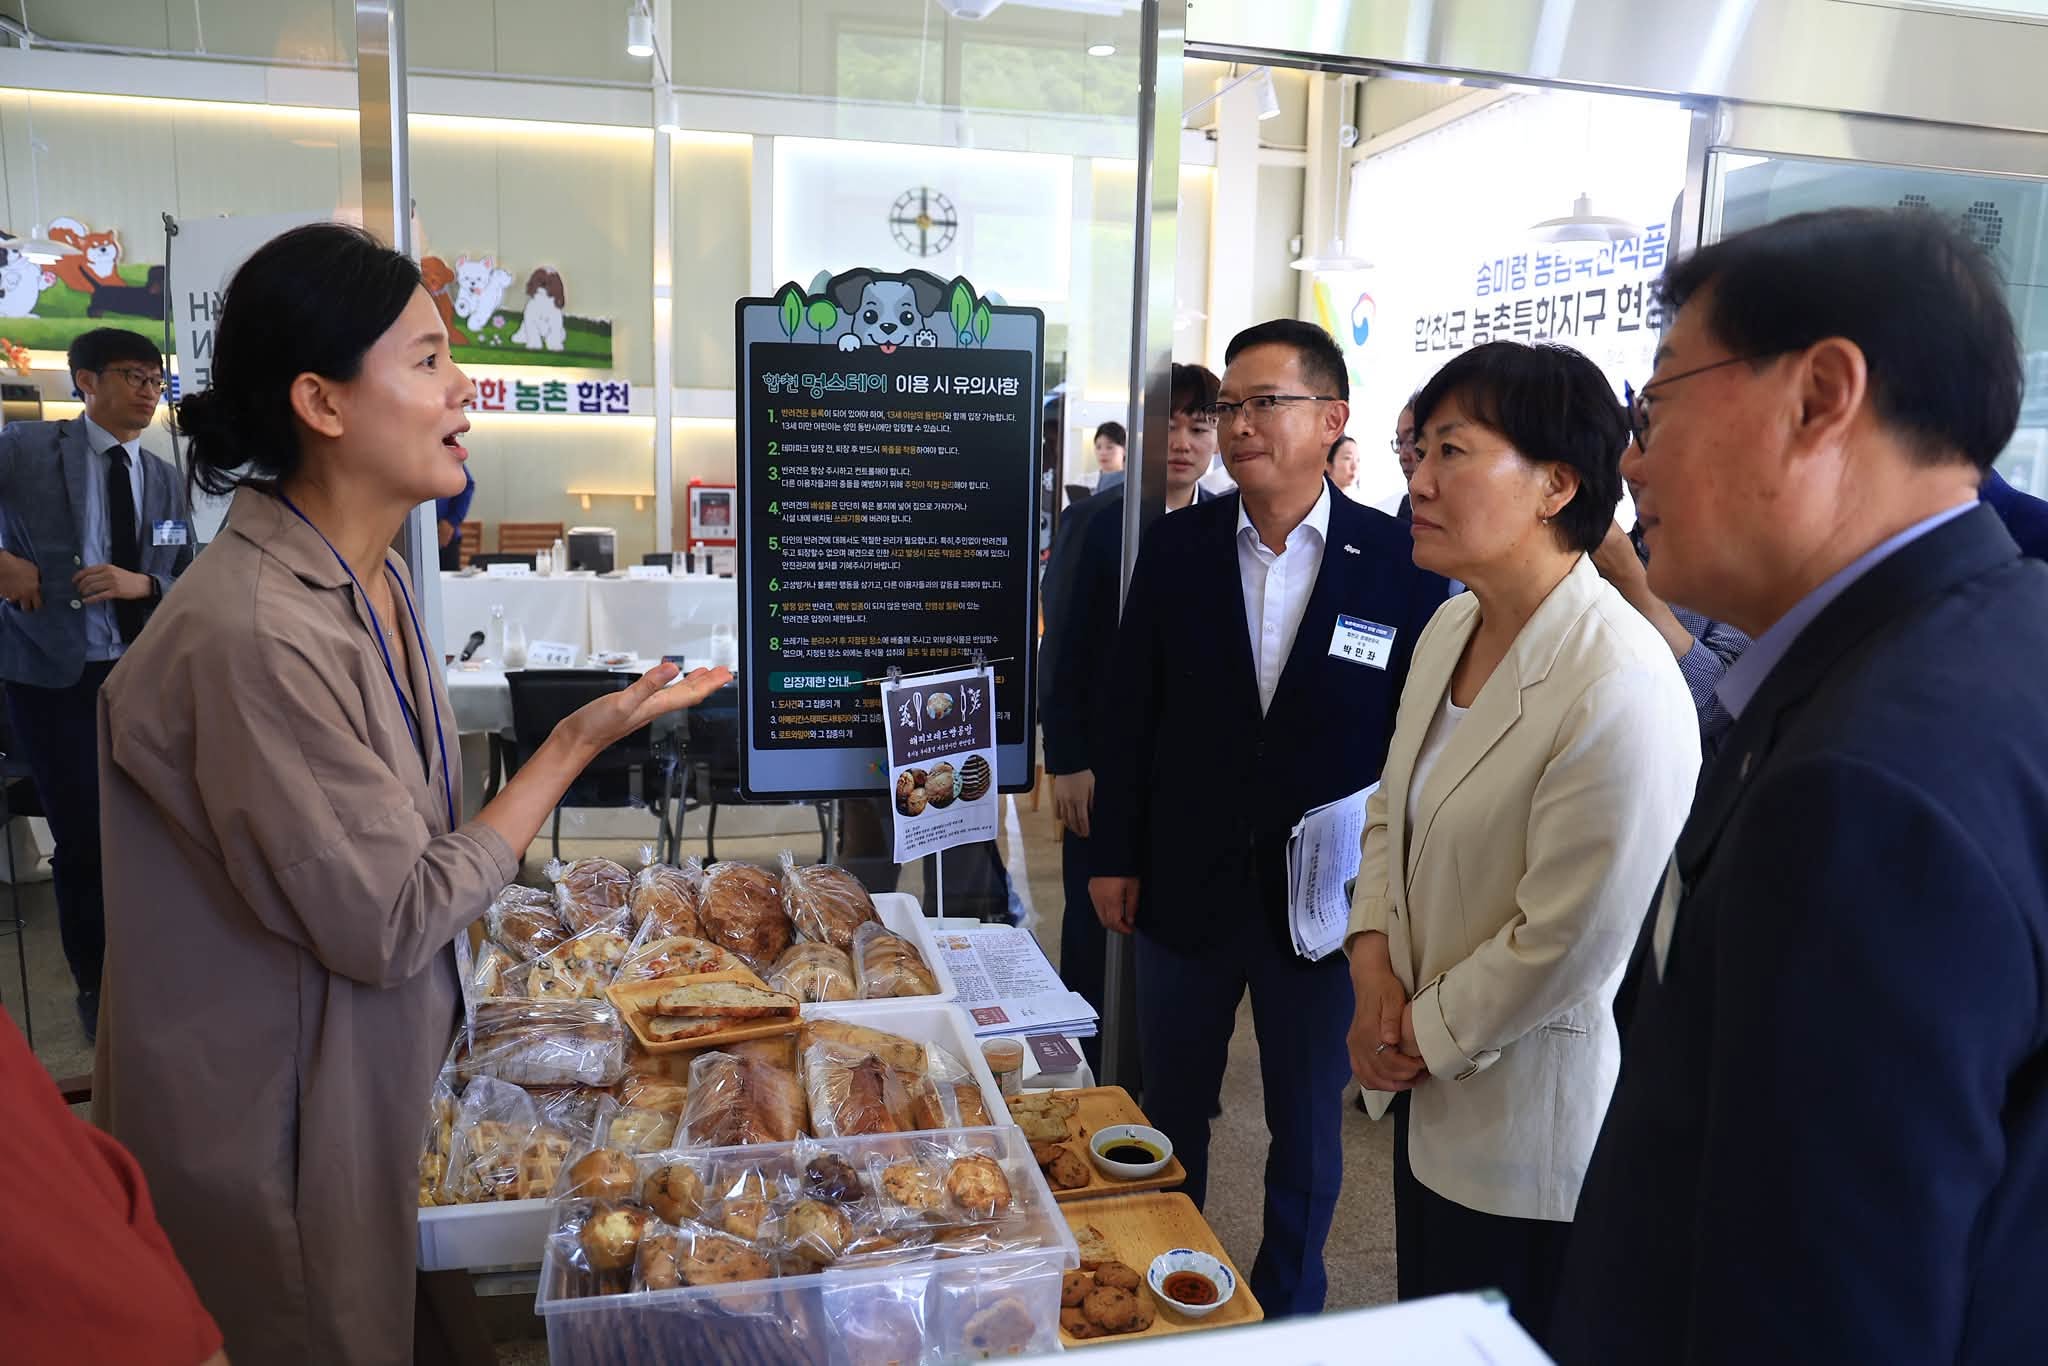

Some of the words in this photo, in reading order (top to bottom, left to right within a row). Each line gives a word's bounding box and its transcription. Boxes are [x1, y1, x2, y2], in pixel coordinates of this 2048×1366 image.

[1476, 253, 1528, 296] 송미령
[1415, 311, 1465, 352] 합천군
[1472, 288, 1607, 347] 농촌특화지구
[762, 373, 798, 393] 합천
[802, 373, 887, 399] 멍스테이
[897, 375, 928, 393] 이용
[934, 376, 948, 394] 시
[954, 377, 1019, 396] 유의사항
[471, 379, 507, 410] 한
[515, 379, 568, 412] 농촌
[578, 382, 631, 414] 합천
[767, 409, 778, 423] 1.
[768, 441, 780, 456] 2.
[768, 466, 780, 480] 3.
[768, 501, 781, 514] 4.
[768, 536, 780, 550] 5.
[768, 578, 782, 592] 6.
[768, 604, 781, 617] 7.
[769, 637, 782, 650] 8.
[784, 677, 826, 688] 입장제한
[828, 676, 850, 687] 안내
